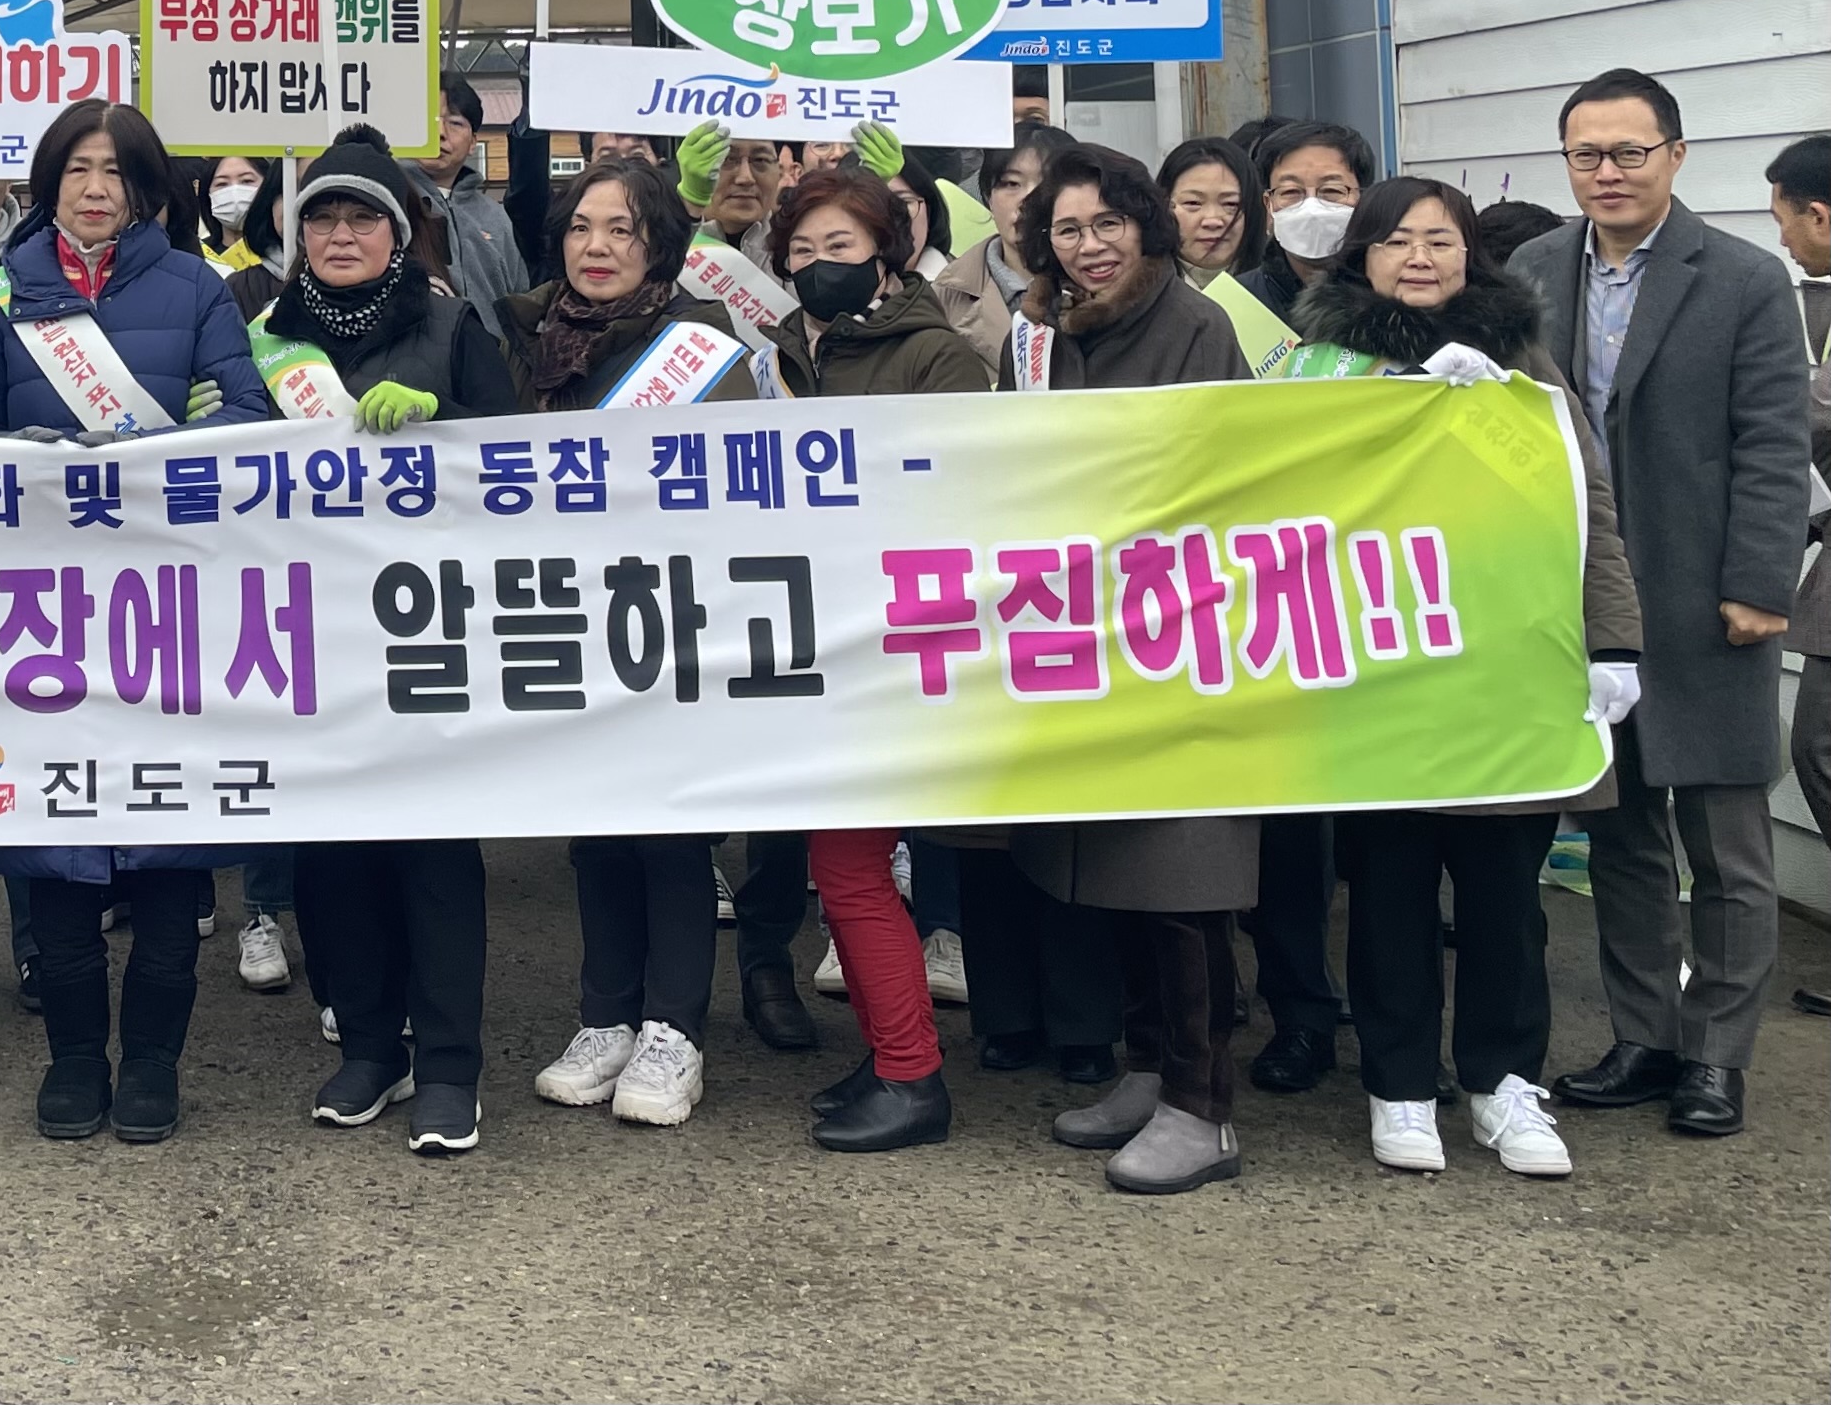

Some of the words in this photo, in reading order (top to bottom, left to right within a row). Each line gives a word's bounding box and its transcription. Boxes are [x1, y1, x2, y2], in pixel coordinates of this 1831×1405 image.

[208, 60, 269, 114] 하지
[637, 78, 763, 118] Jindo
[796, 86, 901, 124] 진도군
[698, 261, 735, 296] 때는
[52, 336, 98, 388] 원산지
[85, 381, 123, 420] 표시
[661, 343, 706, 387] 때는
[65, 463, 122, 530] 및
[163, 443, 438, 522] 물가안정
[478, 437, 610, 516] 동참
[650, 427, 860, 511] 캠페인
[371, 555, 825, 714] 알뜰하고
[881, 515, 1464, 697] 푸짐하게!!
[39, 759, 277, 819] 진도군
